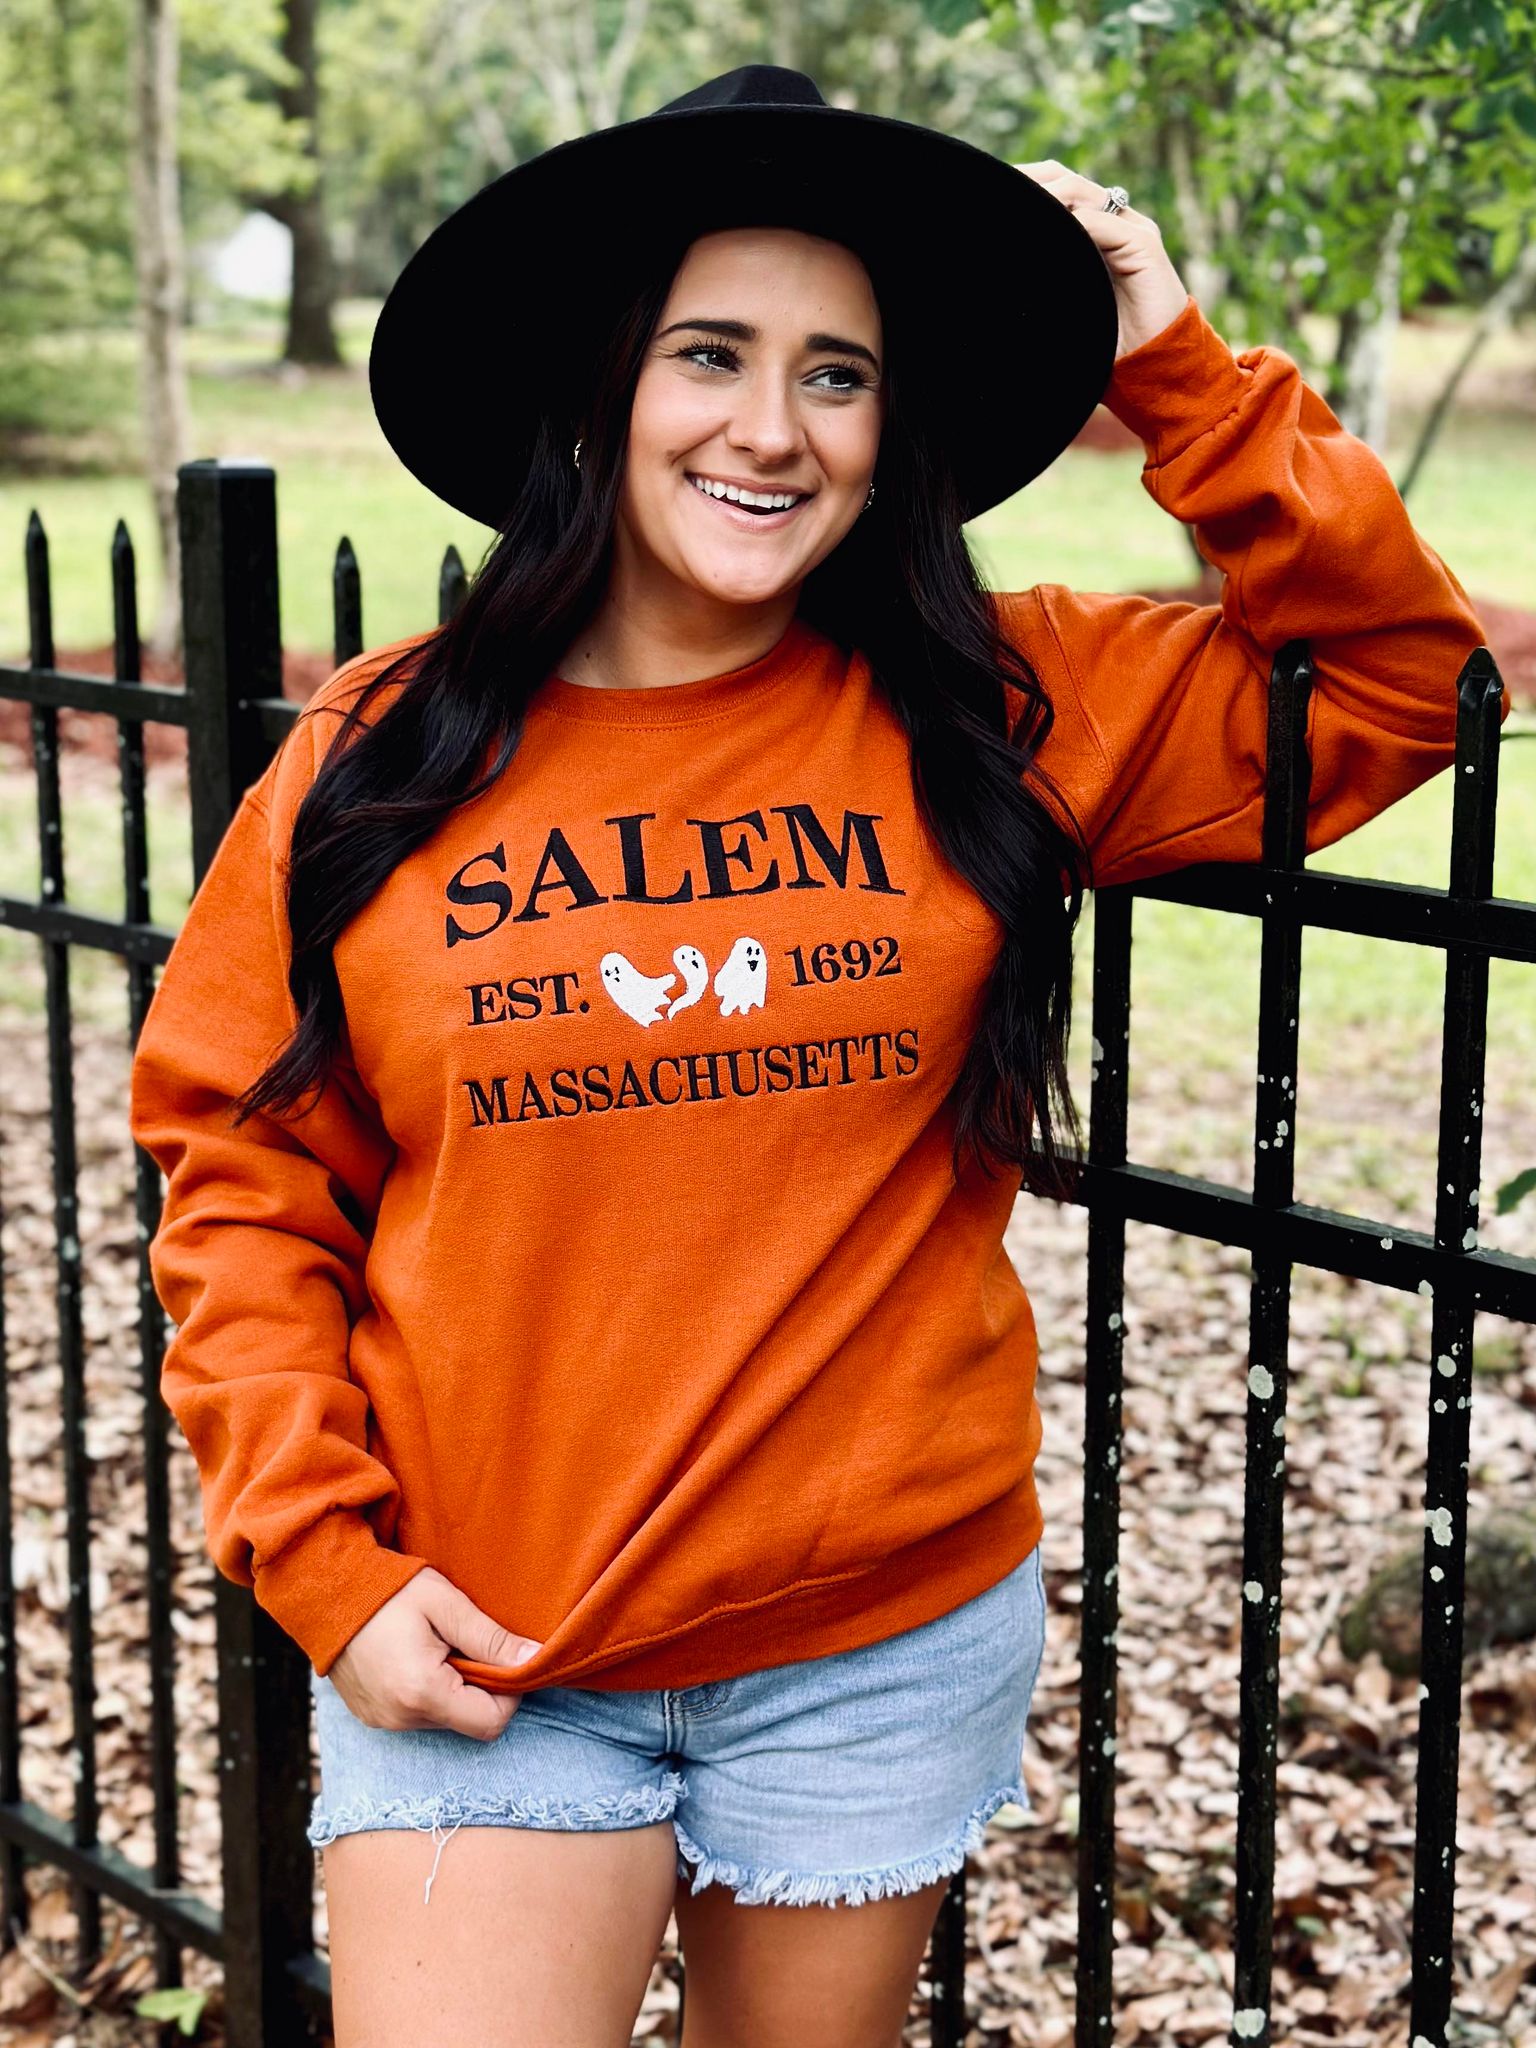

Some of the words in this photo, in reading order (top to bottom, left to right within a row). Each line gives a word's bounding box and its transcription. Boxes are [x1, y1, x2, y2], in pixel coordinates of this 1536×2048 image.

[446, 803, 906, 948] SALEM
[466, 972, 590, 1026] EST.
[786, 936, 902, 987] 1692
[463, 1029, 920, 1127] MASSACHUSETTS
